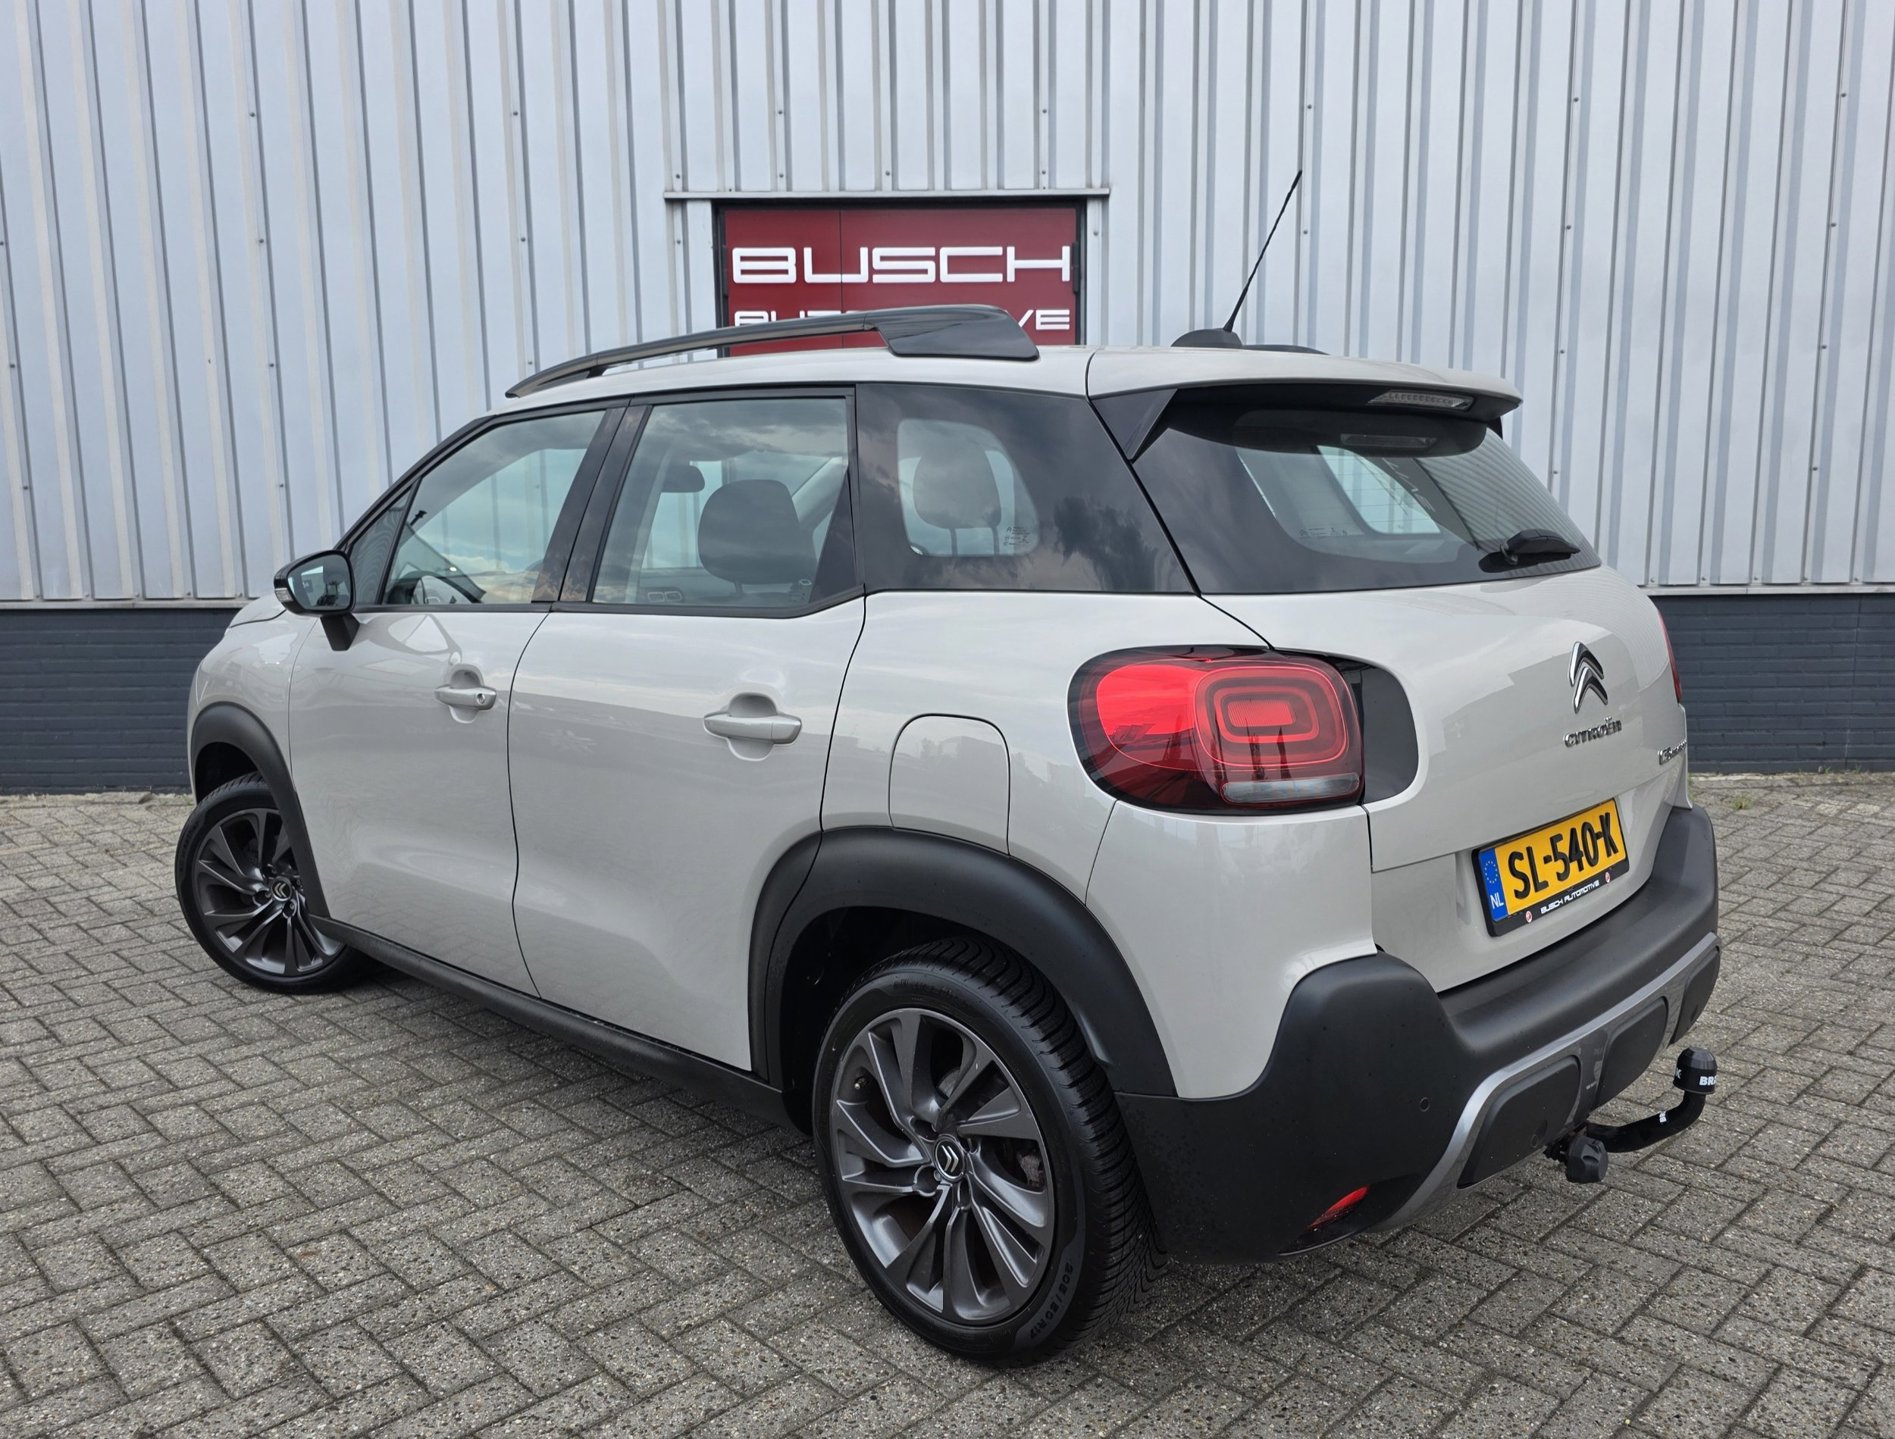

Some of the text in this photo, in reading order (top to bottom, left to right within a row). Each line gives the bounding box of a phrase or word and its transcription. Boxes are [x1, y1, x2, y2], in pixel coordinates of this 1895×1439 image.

[732, 246, 1071, 284] BUSCH
[1508, 812, 1619, 900] SL-540-K
[1489, 892, 1505, 909] NL
[1540, 880, 1600, 915] BUSCH AUTOMOTIVE
